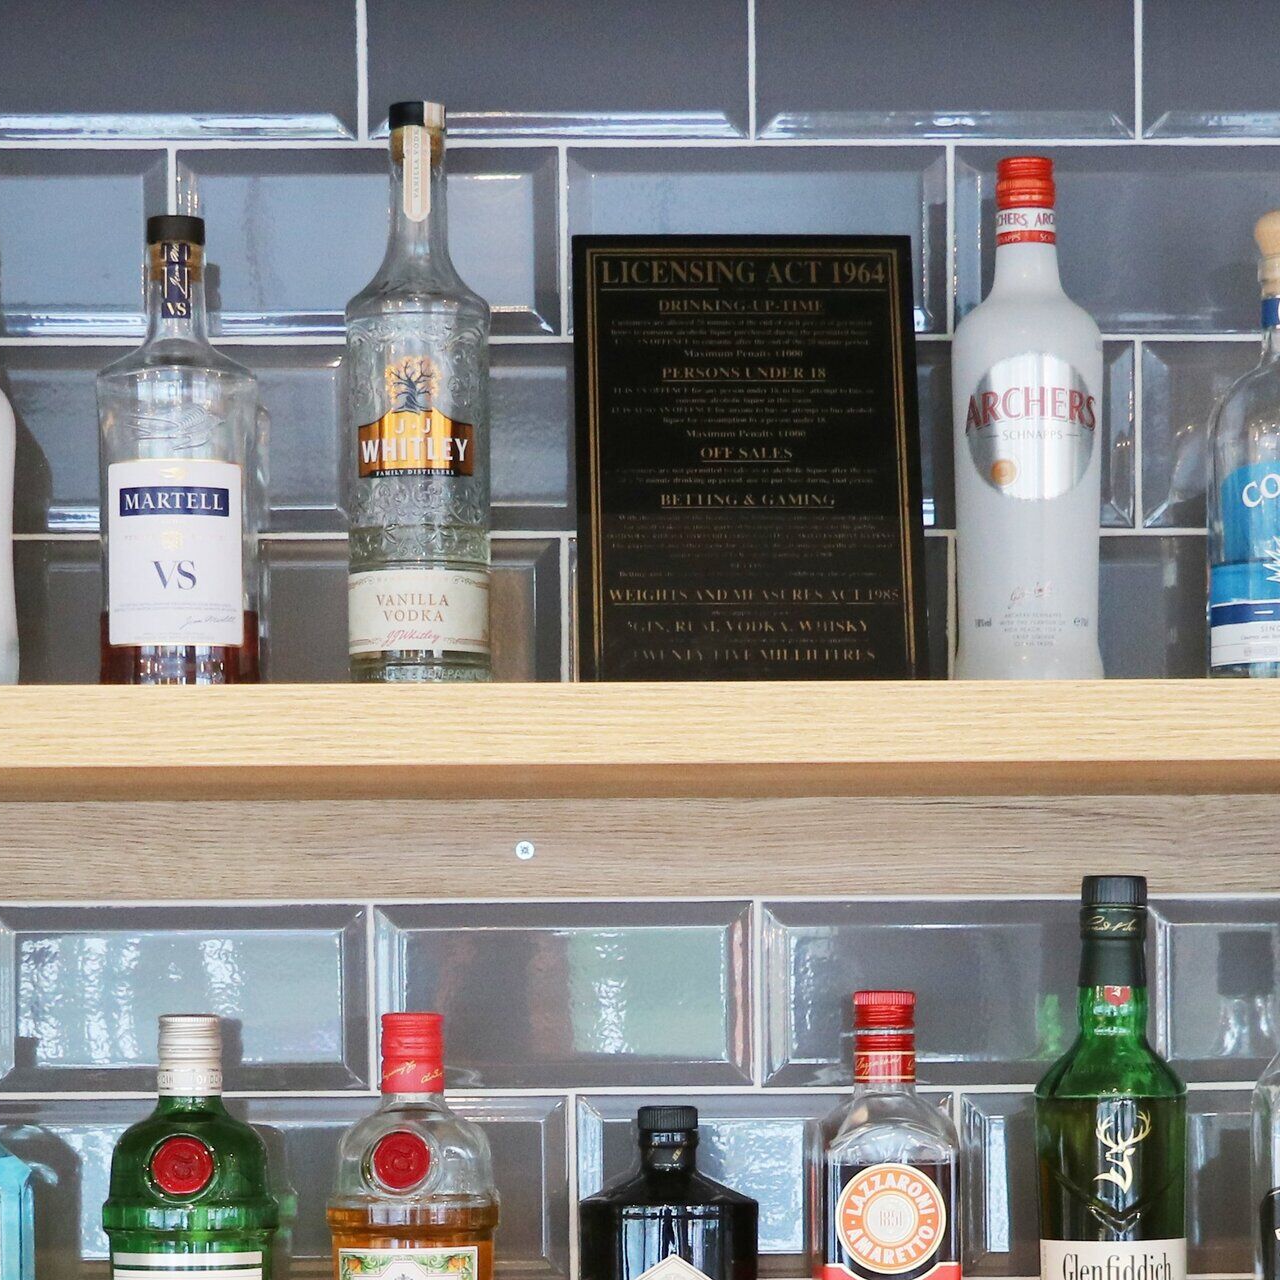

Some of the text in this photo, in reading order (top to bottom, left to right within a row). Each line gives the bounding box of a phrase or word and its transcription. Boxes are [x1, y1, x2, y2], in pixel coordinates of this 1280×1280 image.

[996, 212, 1027, 227] CHERS
[601, 259, 886, 285] LICENSING ACT 1964
[165, 301, 188, 318] VS
[662, 367, 827, 380] PERSONS UNDER 18
[965, 386, 1097, 437] ARCHERS
[1001, 429, 1063, 441] SCHNAPPS
[361, 437, 469, 464] WHITLEY
[700, 447, 794, 459] OFF SALES
[407, 468, 455, 476] DISTILLERS
[124, 491, 225, 512] MARTELL
[762, 493, 836, 506] GAMING
[152, 559, 198, 591] VS
[376, 593, 450, 607] VANILLA
[609, 589, 688, 601] WEIGHTS
[383, 609, 444, 623] VODKA
[845, 1171, 936, 1217] LAZZARONI
[845, 1223, 936, 1266] AMARETTO
